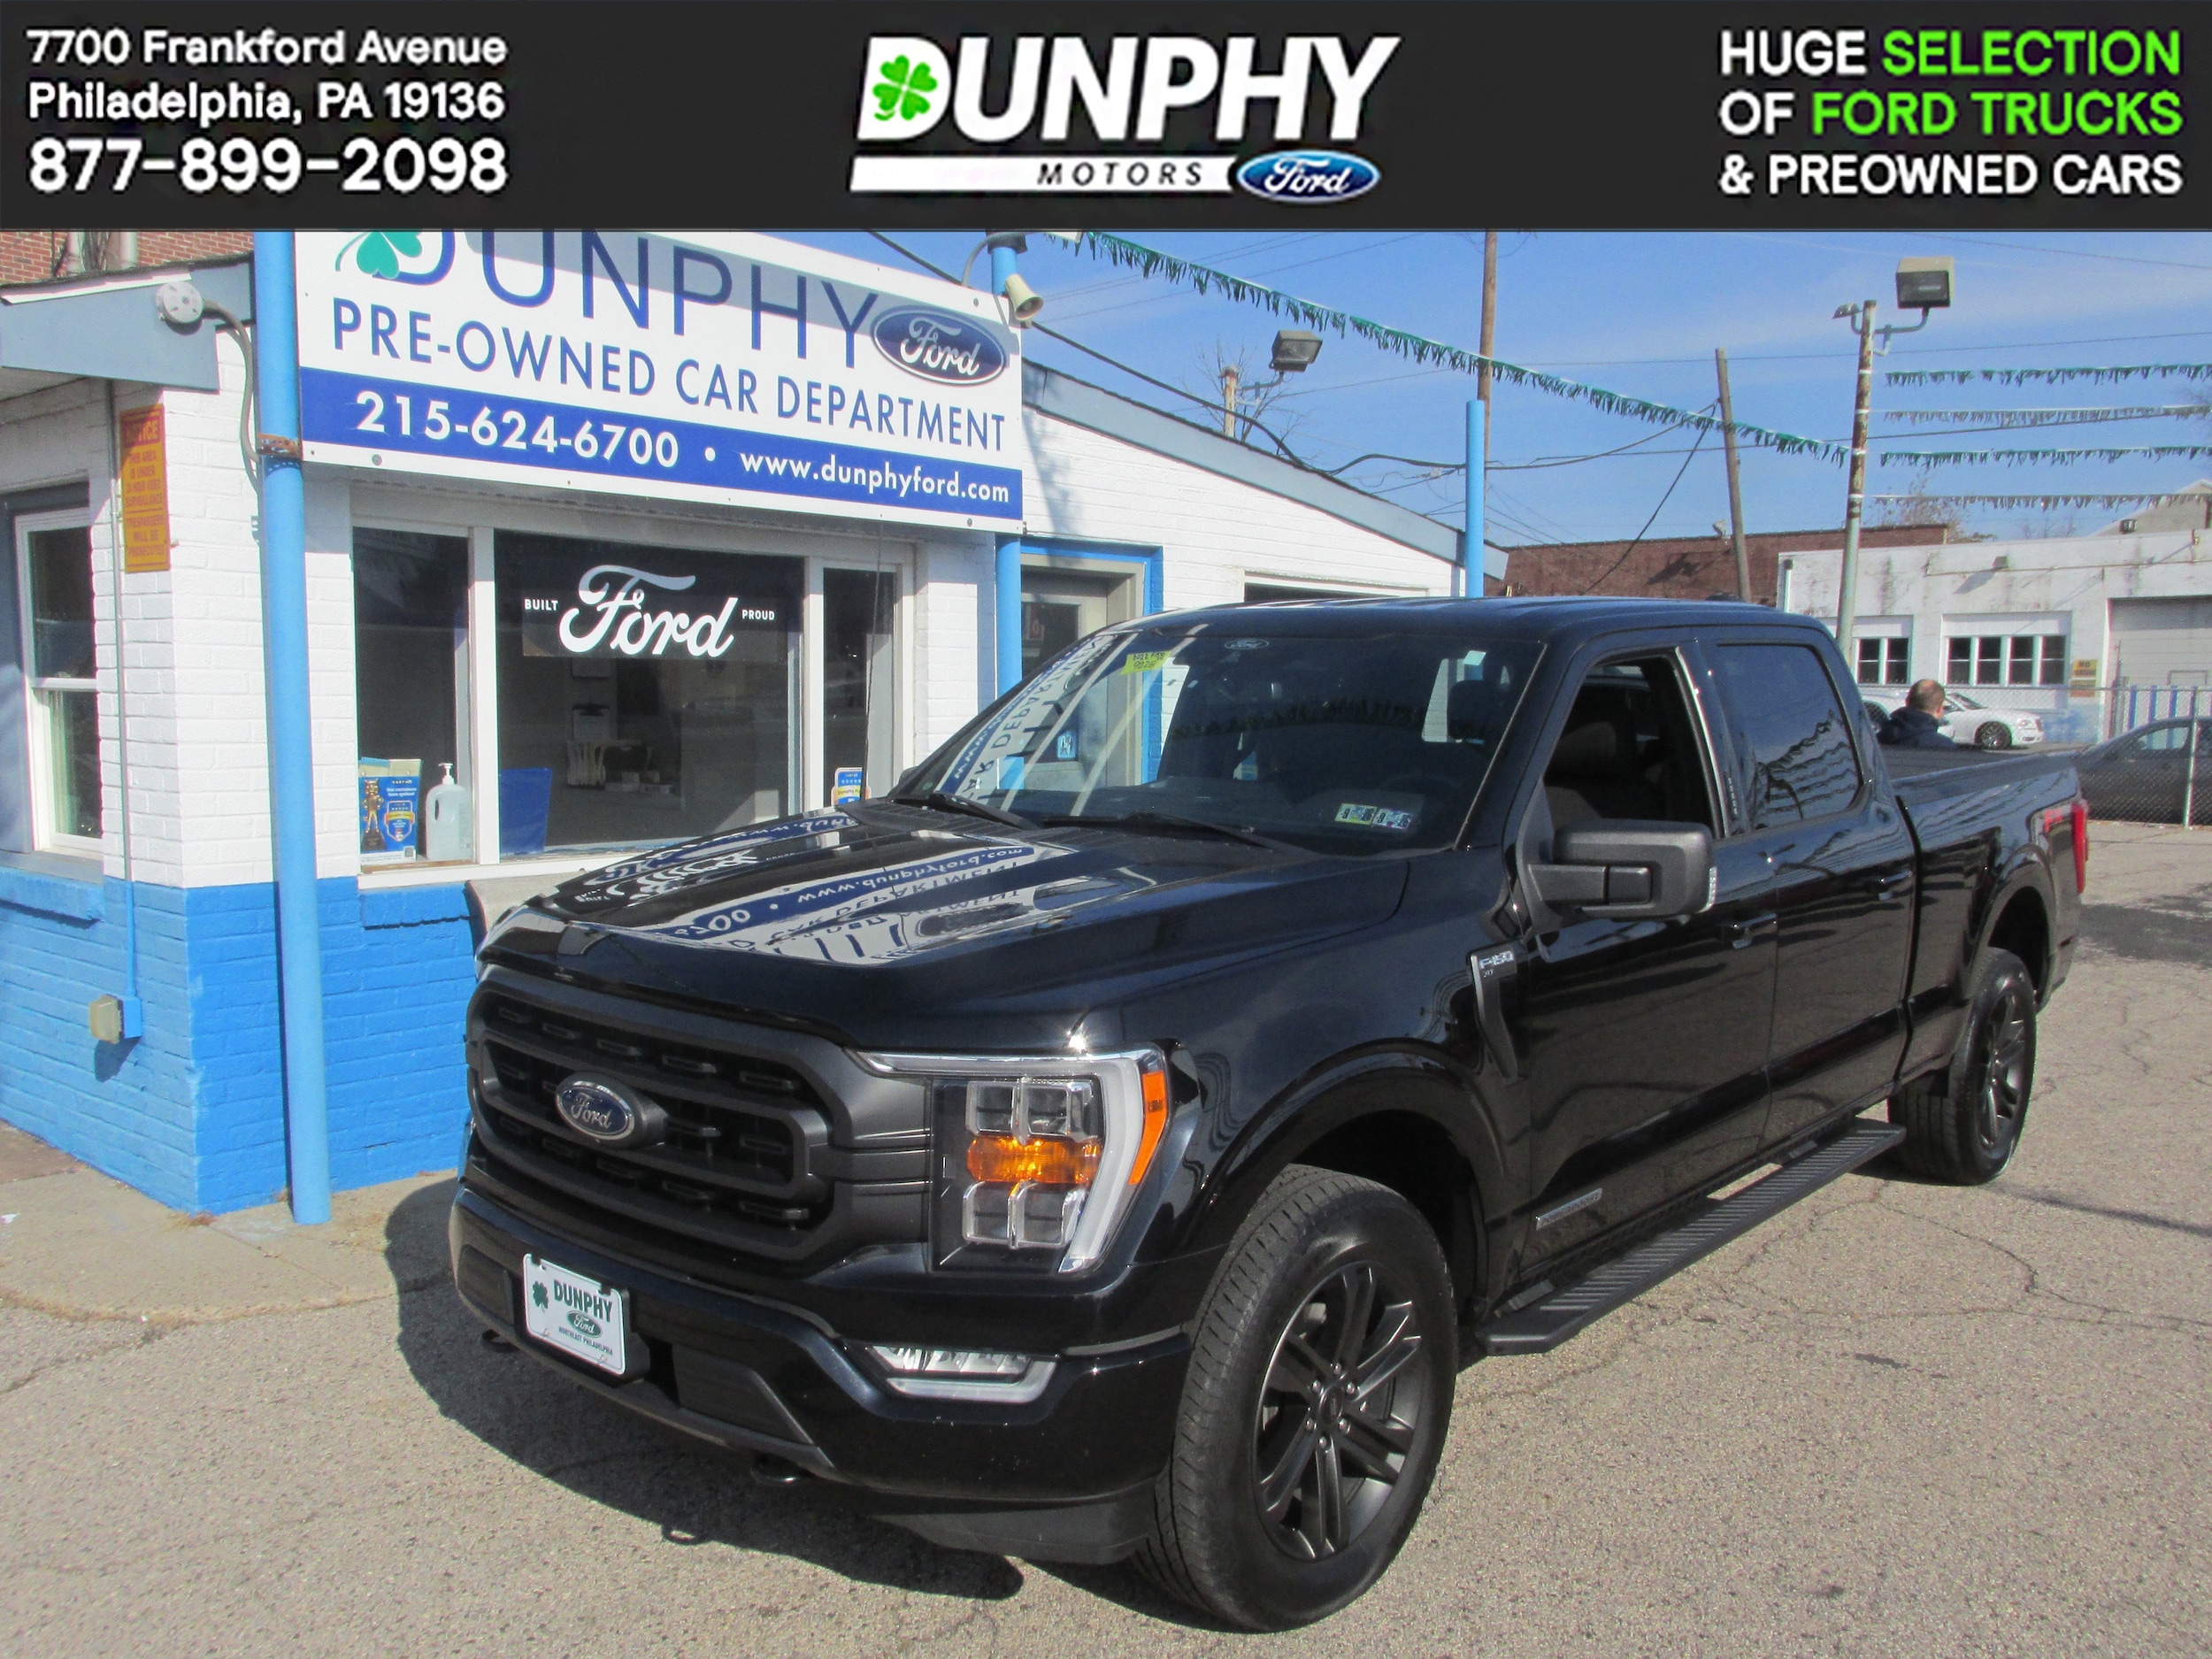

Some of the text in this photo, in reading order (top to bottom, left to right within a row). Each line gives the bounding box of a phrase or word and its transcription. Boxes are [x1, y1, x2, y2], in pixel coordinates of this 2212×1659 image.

[900, 317, 981, 376] Ford
[333, 296, 1005, 452] PRE-OWNED CAR DEPARTMENT
[356, 389, 1010, 503] 215-624-6700 www.dunphyford.com
[524, 598, 559, 611] BUILT
[558, 564, 739, 657] Ford
[741, 609, 775, 621] PROUD
[570, 1092, 612, 1129] Ford
[553, 1279, 613, 1324] DUNPHY
[573, 1313, 595, 1334] Ford
